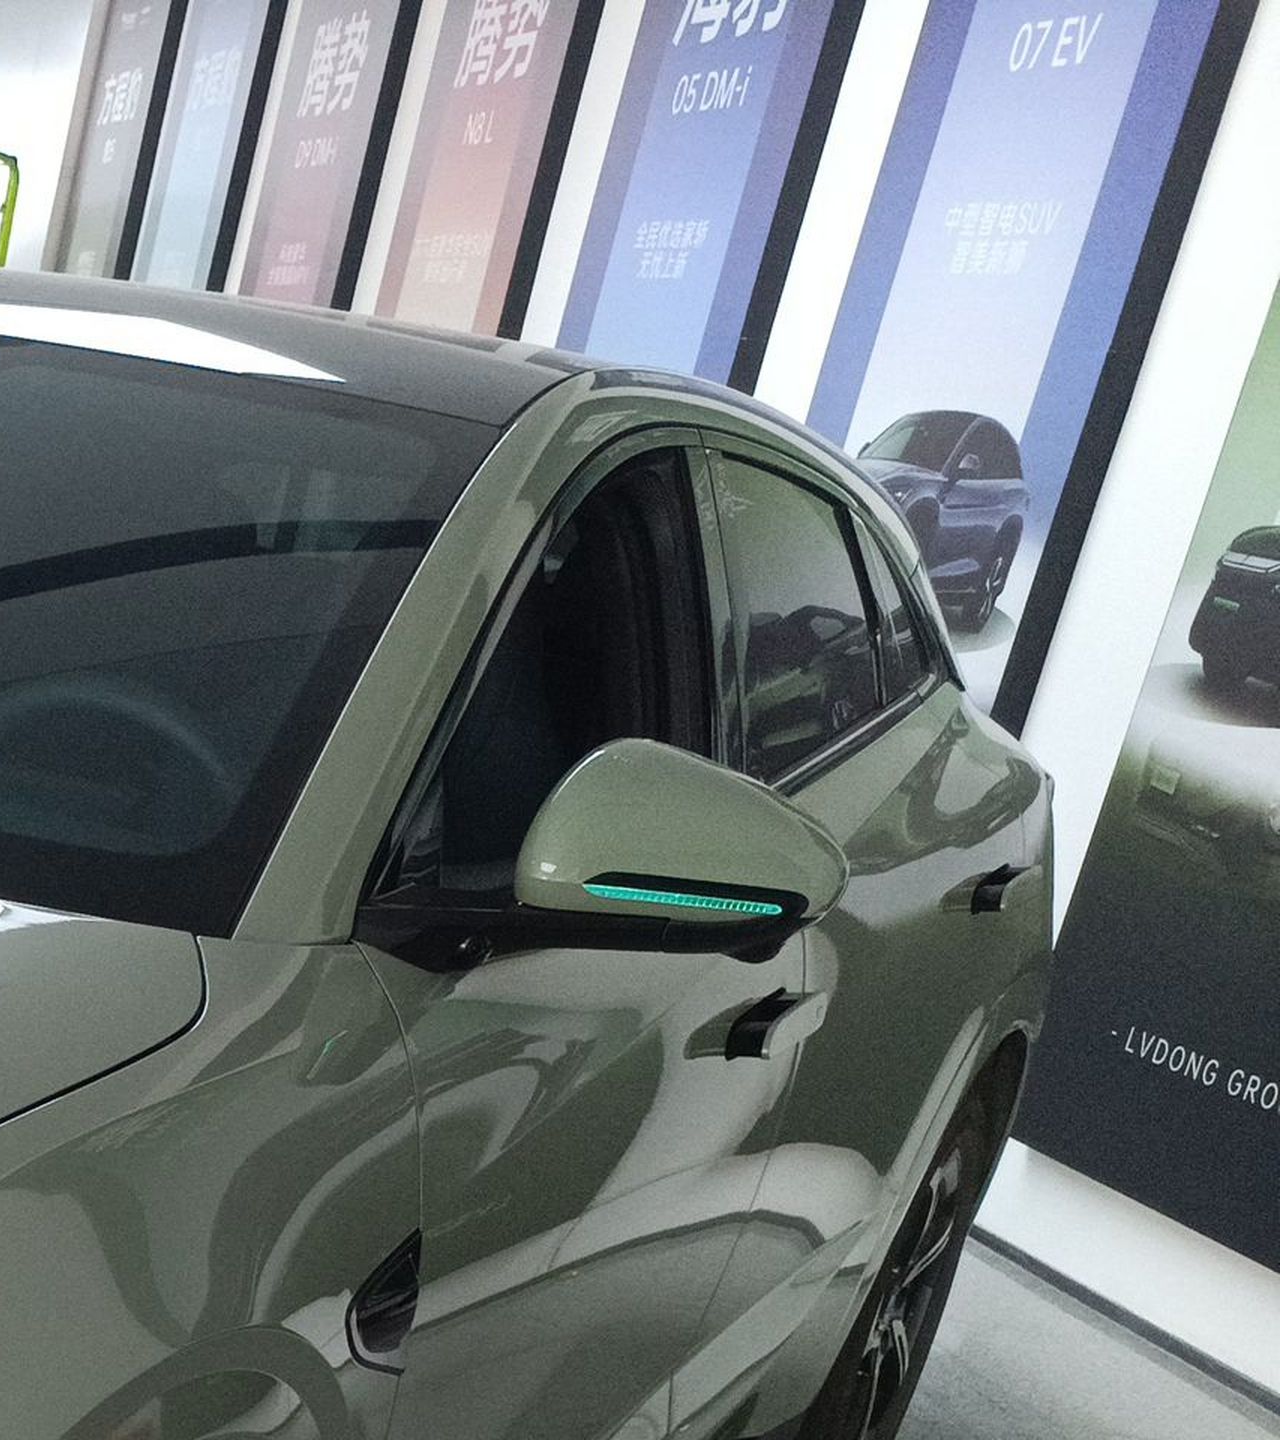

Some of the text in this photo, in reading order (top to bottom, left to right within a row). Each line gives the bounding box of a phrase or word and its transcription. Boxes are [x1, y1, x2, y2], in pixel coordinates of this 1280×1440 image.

[297, 9, 370, 118] 腾势
[1008, 13, 1102, 73] 07 EV
[672, 65, 752, 115] 05 DM-i
[463, 112, 483, 145] N8
[1124, 1026, 1280, 1114] LVDONG GRO
